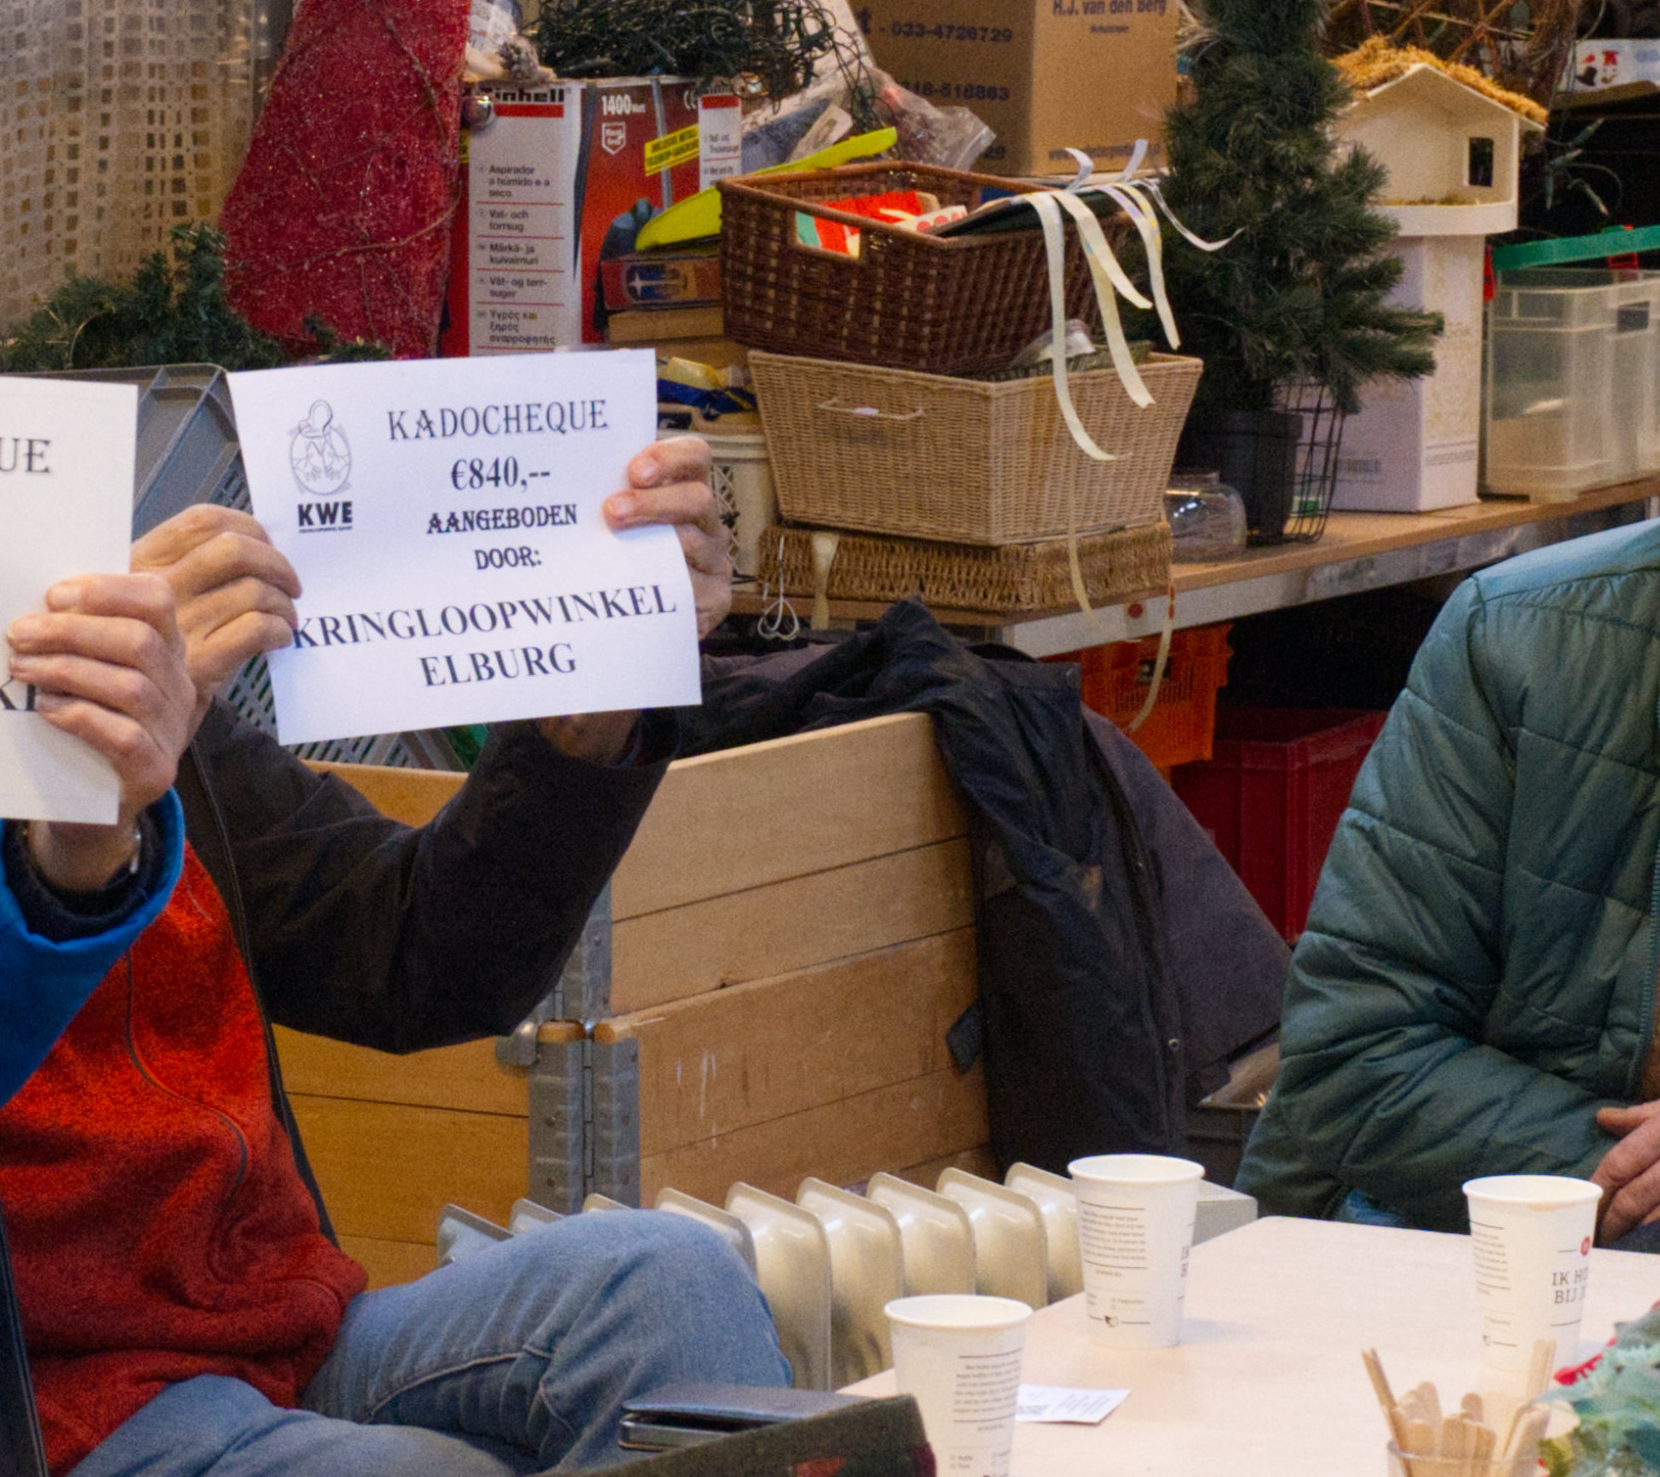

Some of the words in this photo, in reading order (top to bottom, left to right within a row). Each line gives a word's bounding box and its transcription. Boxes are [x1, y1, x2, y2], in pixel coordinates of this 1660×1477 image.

[1082, 0, 1106, 15] van
[479, 87, 565, 103] inhell
[601, 94, 632, 116] 1400
[387, 399, 609, 442] KADOCHEQUE
[449, 456, 551, 493] €840,--
[296, 501, 354, 527] KWE
[426, 503, 579, 535] AANGEBODEN
[473, 546, 544, 571] DOOR:
[291, 583, 678, 650] KRINGLOOPWINKEL
[418, 641, 578, 689] ELBURG
[1551, 1270, 1570, 1287] IK
[1553, 1286, 1578, 1305] BIJ
